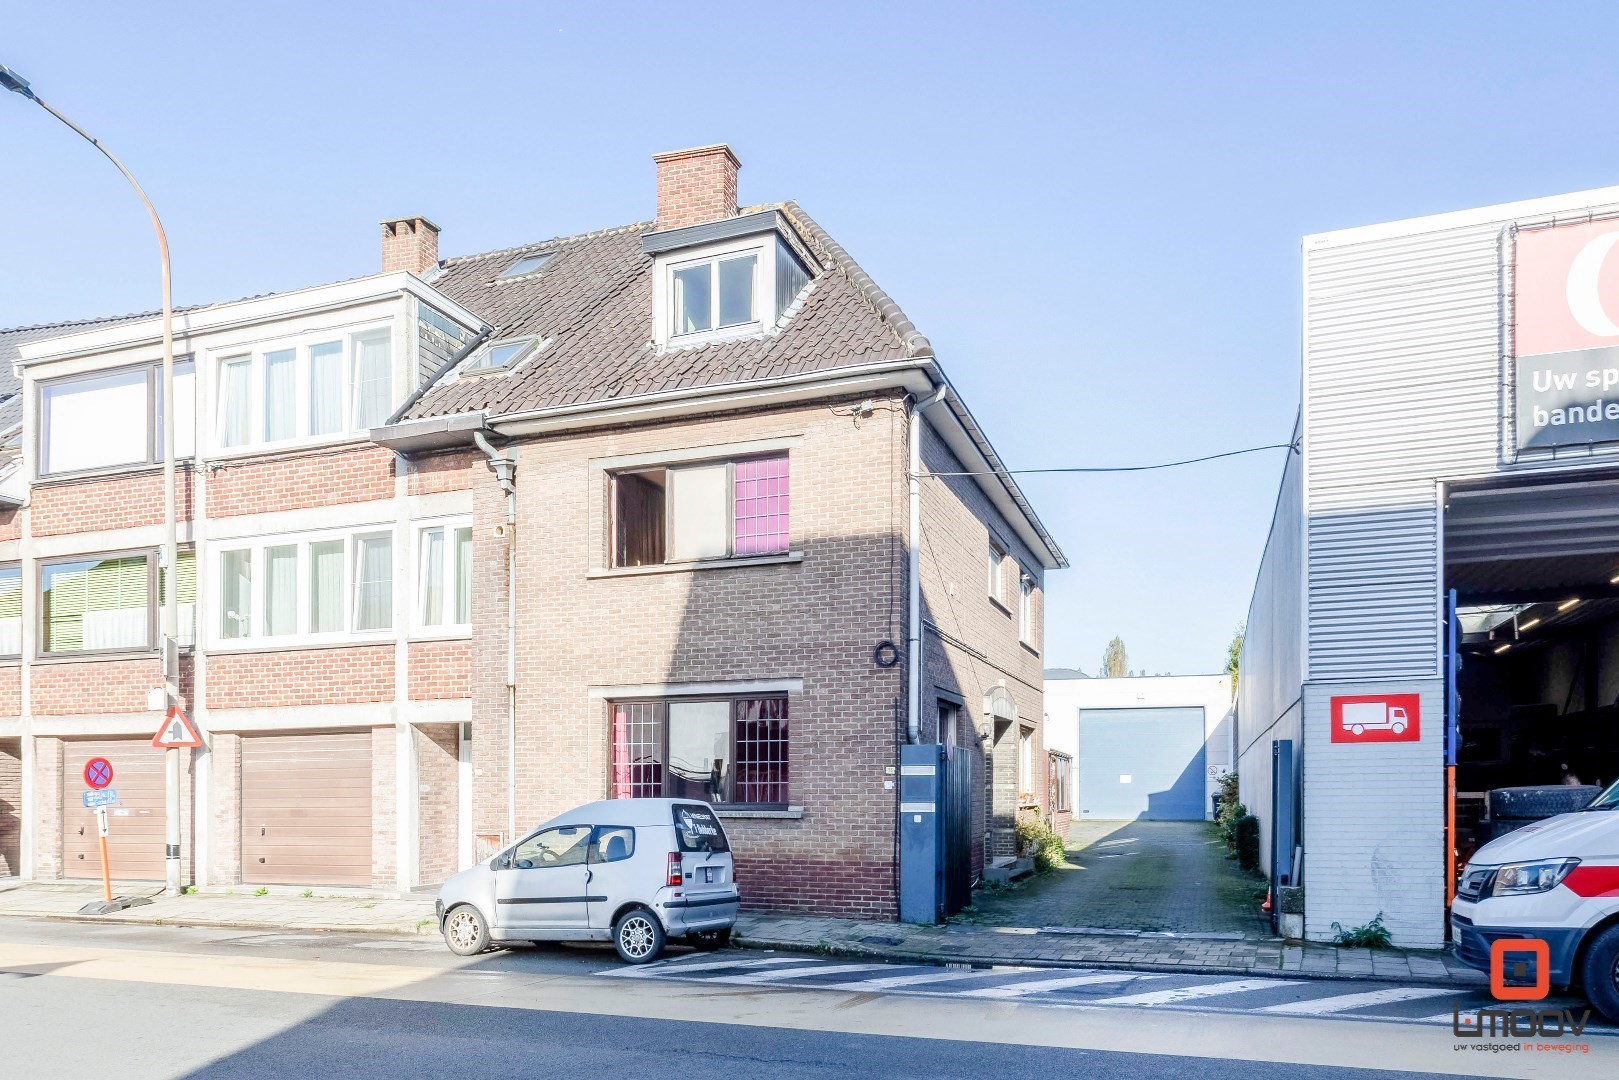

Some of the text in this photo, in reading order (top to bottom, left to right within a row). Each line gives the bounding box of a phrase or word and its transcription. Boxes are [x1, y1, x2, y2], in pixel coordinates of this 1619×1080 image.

[1533, 368, 1619, 393] Uw sp
[1533, 398, 1619, 427] bande
